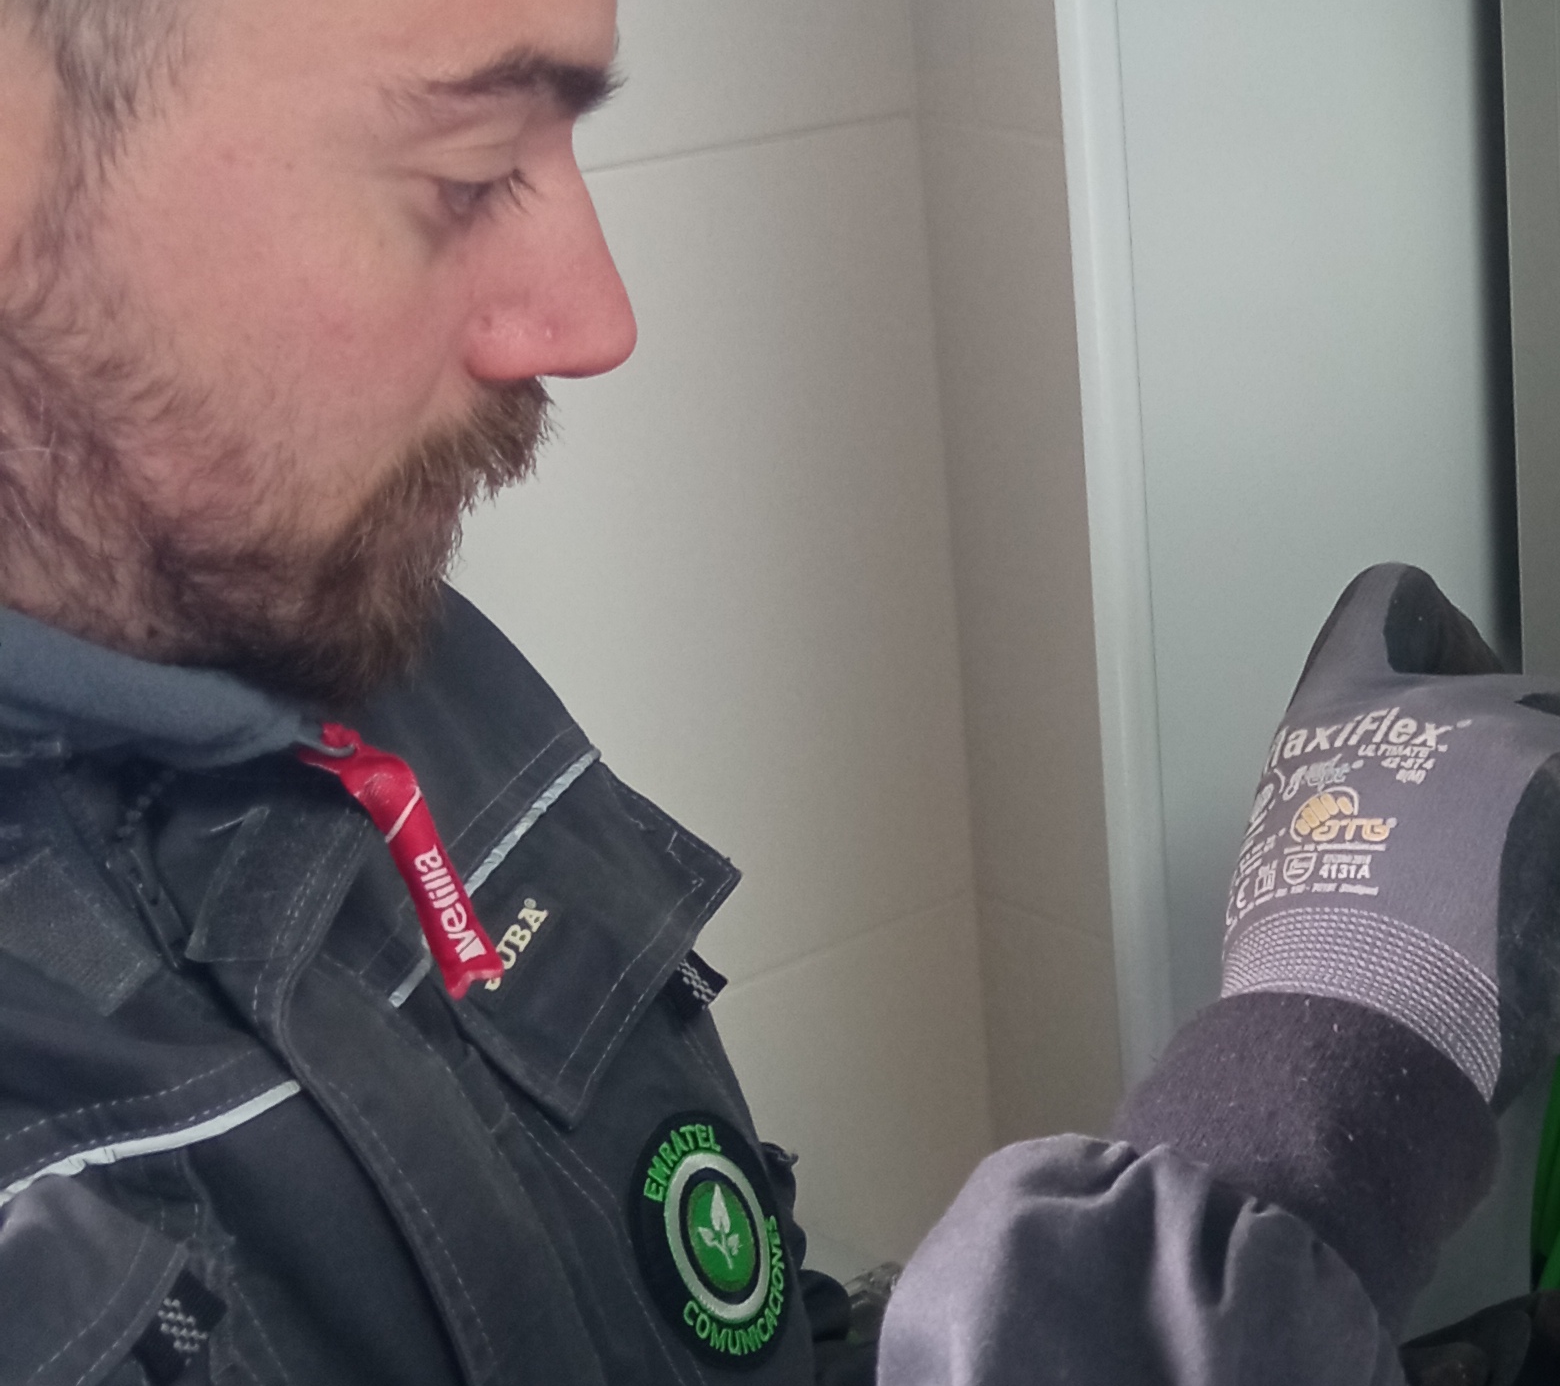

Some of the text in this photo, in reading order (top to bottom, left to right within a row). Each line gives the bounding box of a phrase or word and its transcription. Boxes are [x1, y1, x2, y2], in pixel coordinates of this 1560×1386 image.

[1319, 864, 1371, 880] 4131A
[644, 1124, 722, 1203] EMRATEL
[684, 1215, 785, 1355] COMUNICACIONES
